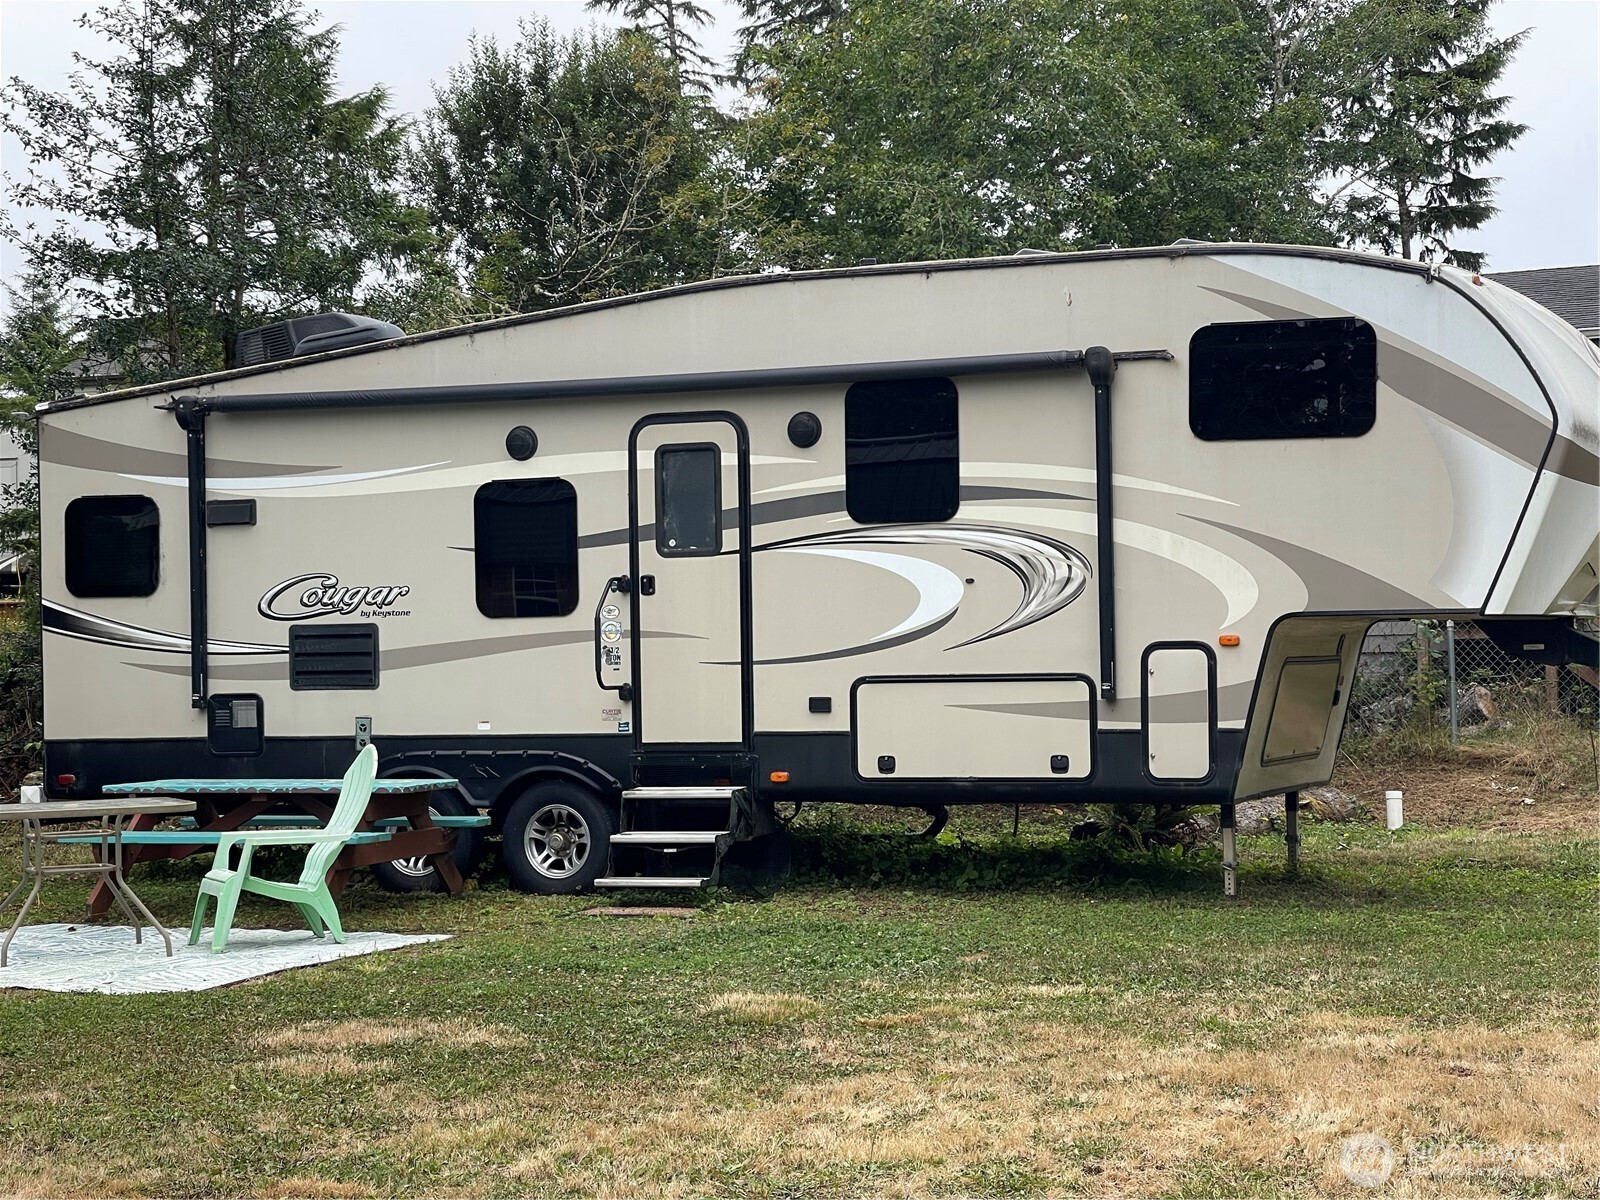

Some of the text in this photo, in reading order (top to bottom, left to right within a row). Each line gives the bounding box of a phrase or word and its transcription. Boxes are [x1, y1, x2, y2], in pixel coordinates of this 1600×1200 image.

[258, 573, 410, 622] Cougar
[360, 609, 411, 618] by Keystone
